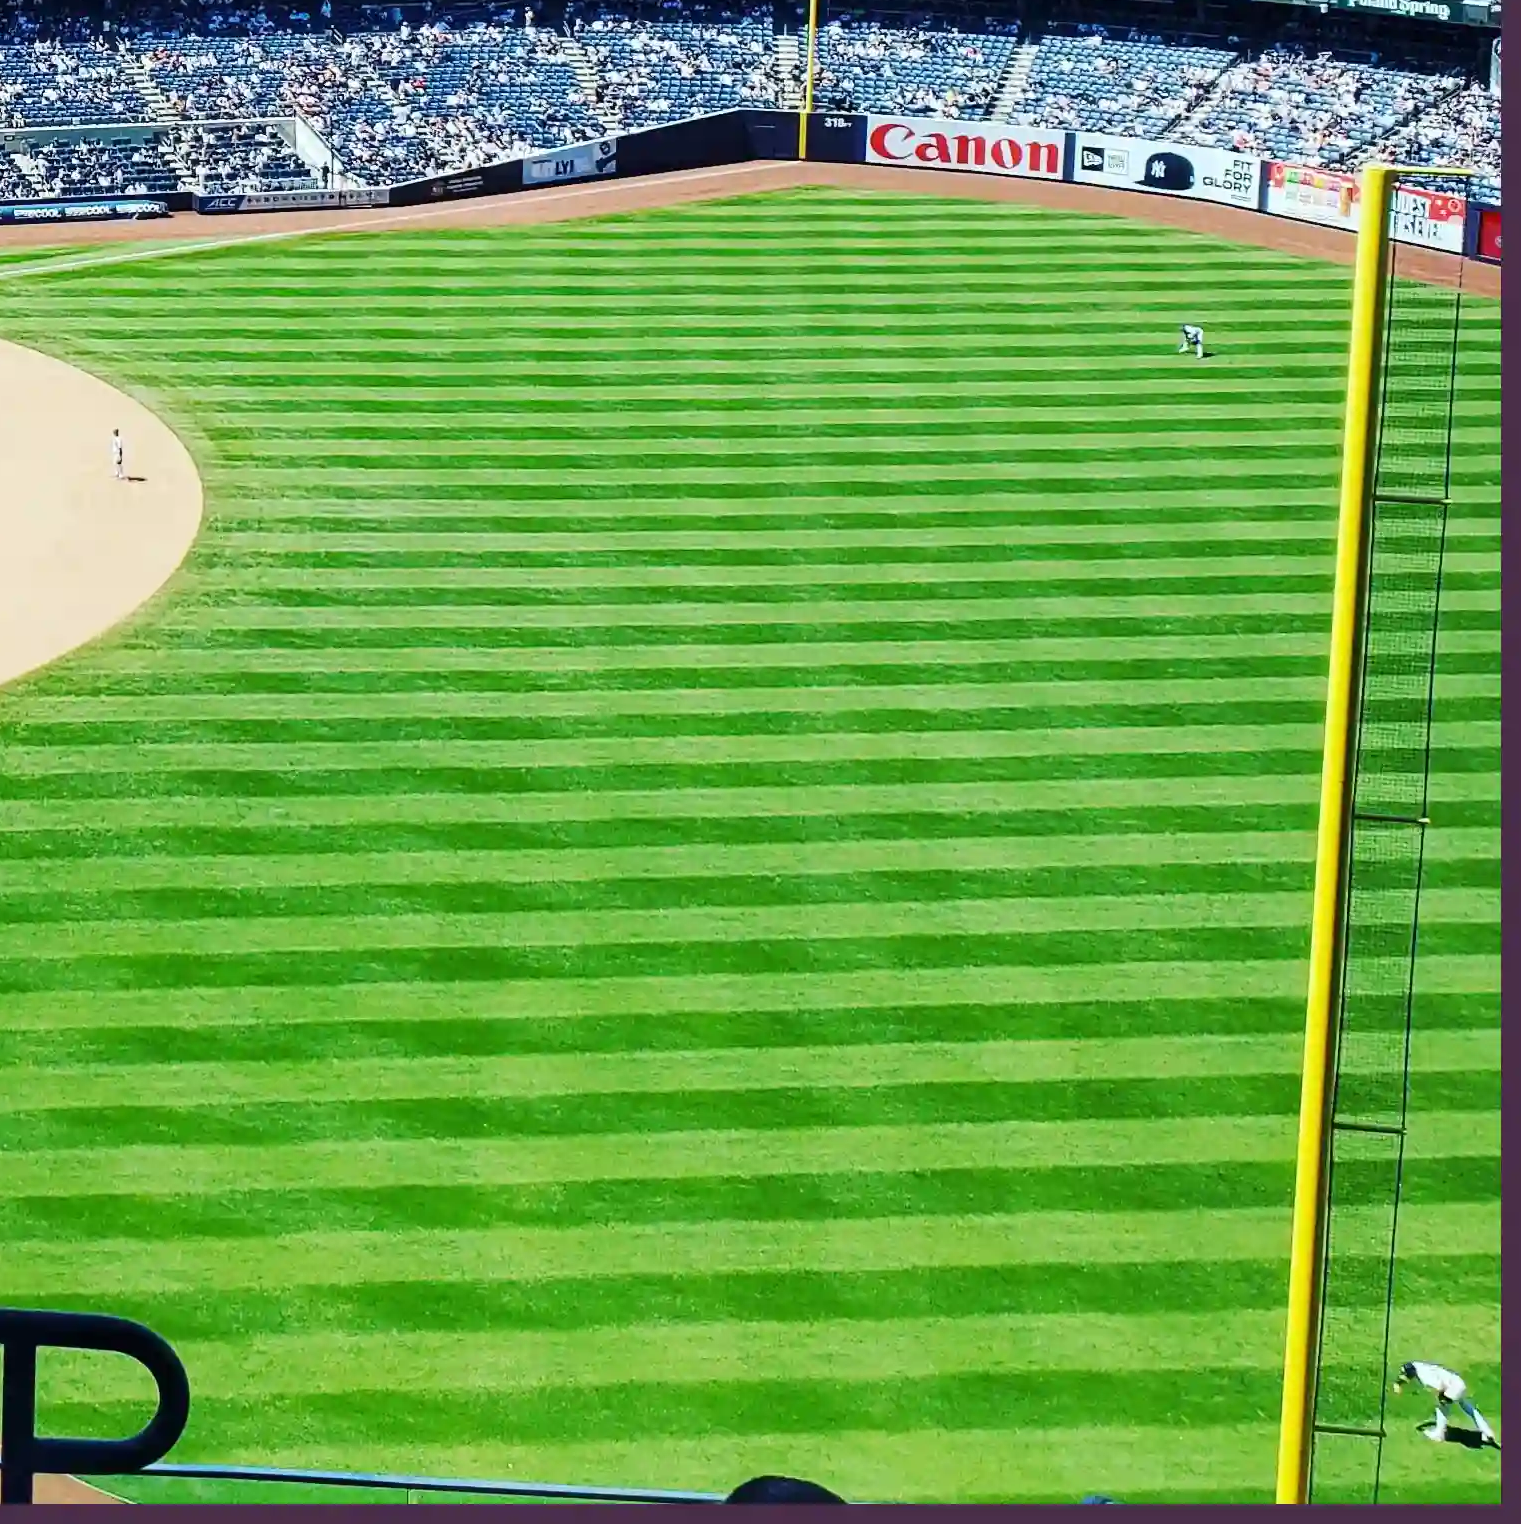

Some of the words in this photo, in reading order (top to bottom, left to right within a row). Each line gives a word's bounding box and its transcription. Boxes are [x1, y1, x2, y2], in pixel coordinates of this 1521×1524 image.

[870, 123, 1058, 174] Canon
[1151, 159, 1166, 178] NY
[1234, 160, 1253, 172] FIT
[1225, 169, 1252, 184] FOR
[1203, 176, 1252, 194] GLORY
[207, 197, 237, 208] ACC
